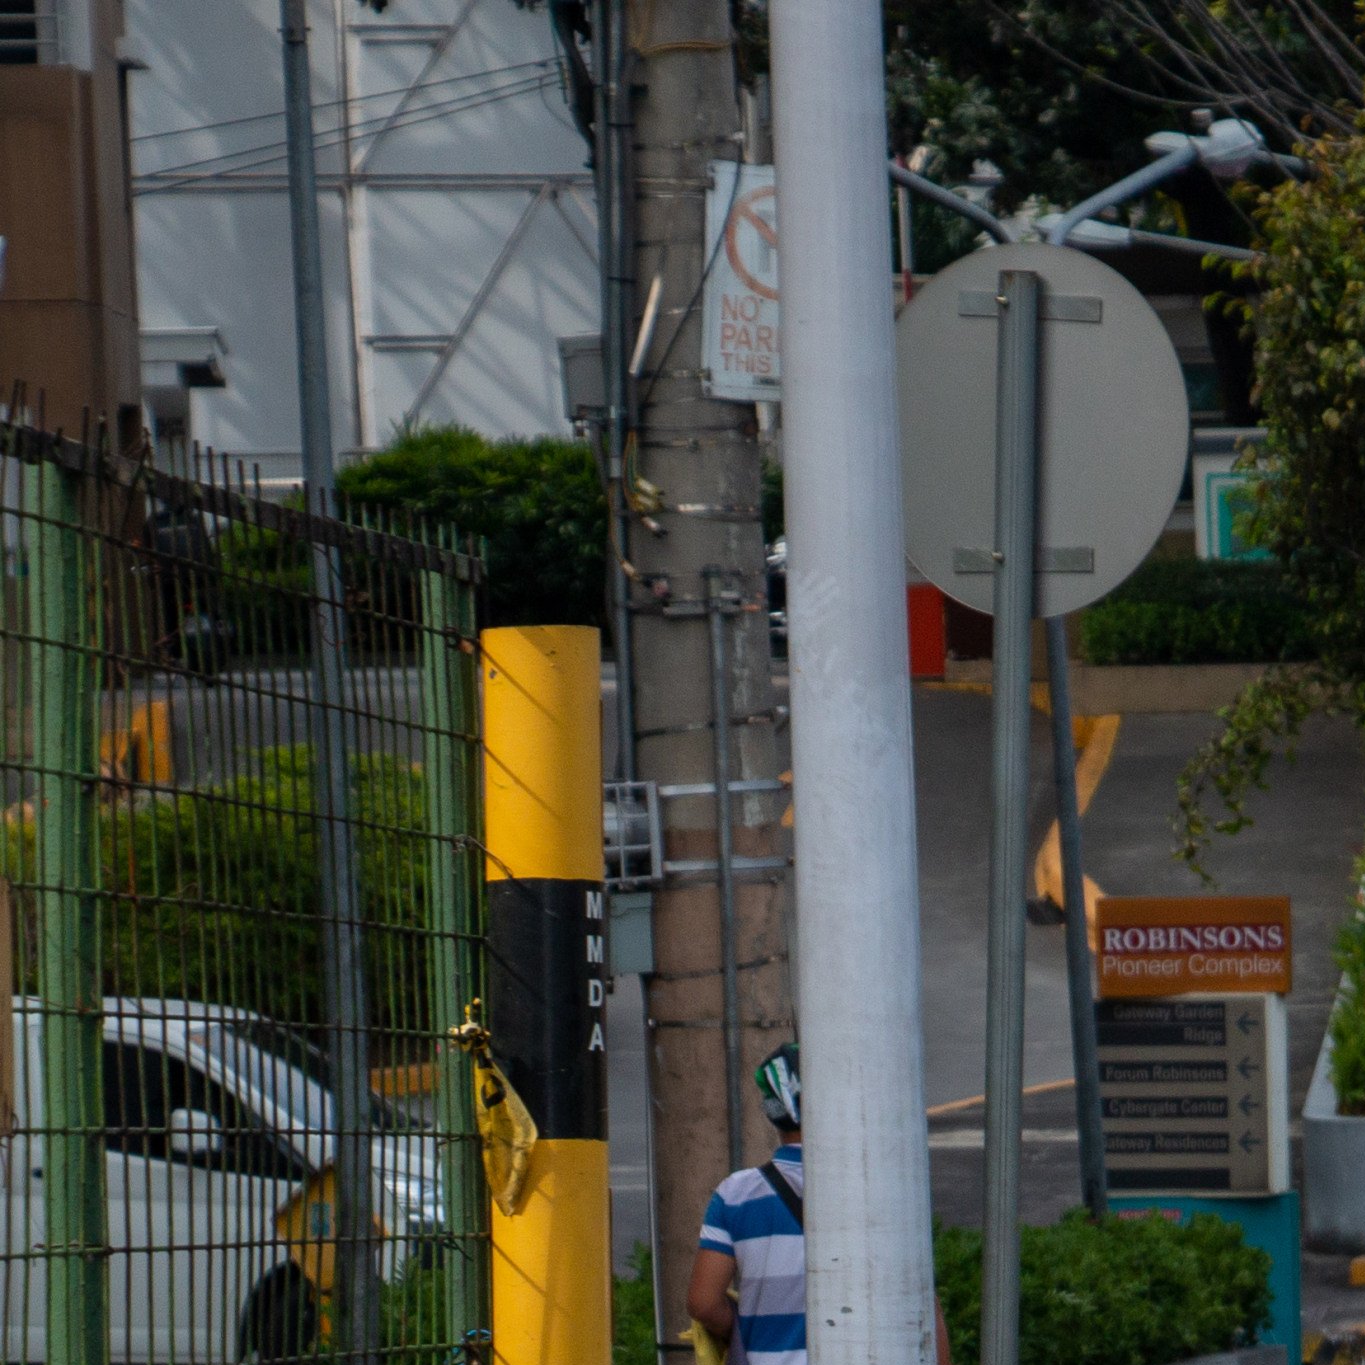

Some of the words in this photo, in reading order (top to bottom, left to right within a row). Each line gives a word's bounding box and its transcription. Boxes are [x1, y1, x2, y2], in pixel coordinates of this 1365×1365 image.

[721, 293, 759, 320] NO
[720, 323, 780, 352] PAR
[720, 352, 772, 373] THIS
[1103, 925, 1284, 951] ROBINSONS
[585, 891, 605, 1051] MMDA
[1103, 955, 1182, 976] Pioneer
[1188, 953, 1283, 978] Complex
[1113, 1004, 1170, 1022] Gateway
[1174, 1004, 1224, 1019] Garden
[1183, 1027, 1223, 1045] Ridge
[1105, 1066, 1149, 1080] Forum
[1152, 1065, 1225, 1080] Robinsons
[1104, 1136, 1151, 1152] ateway
